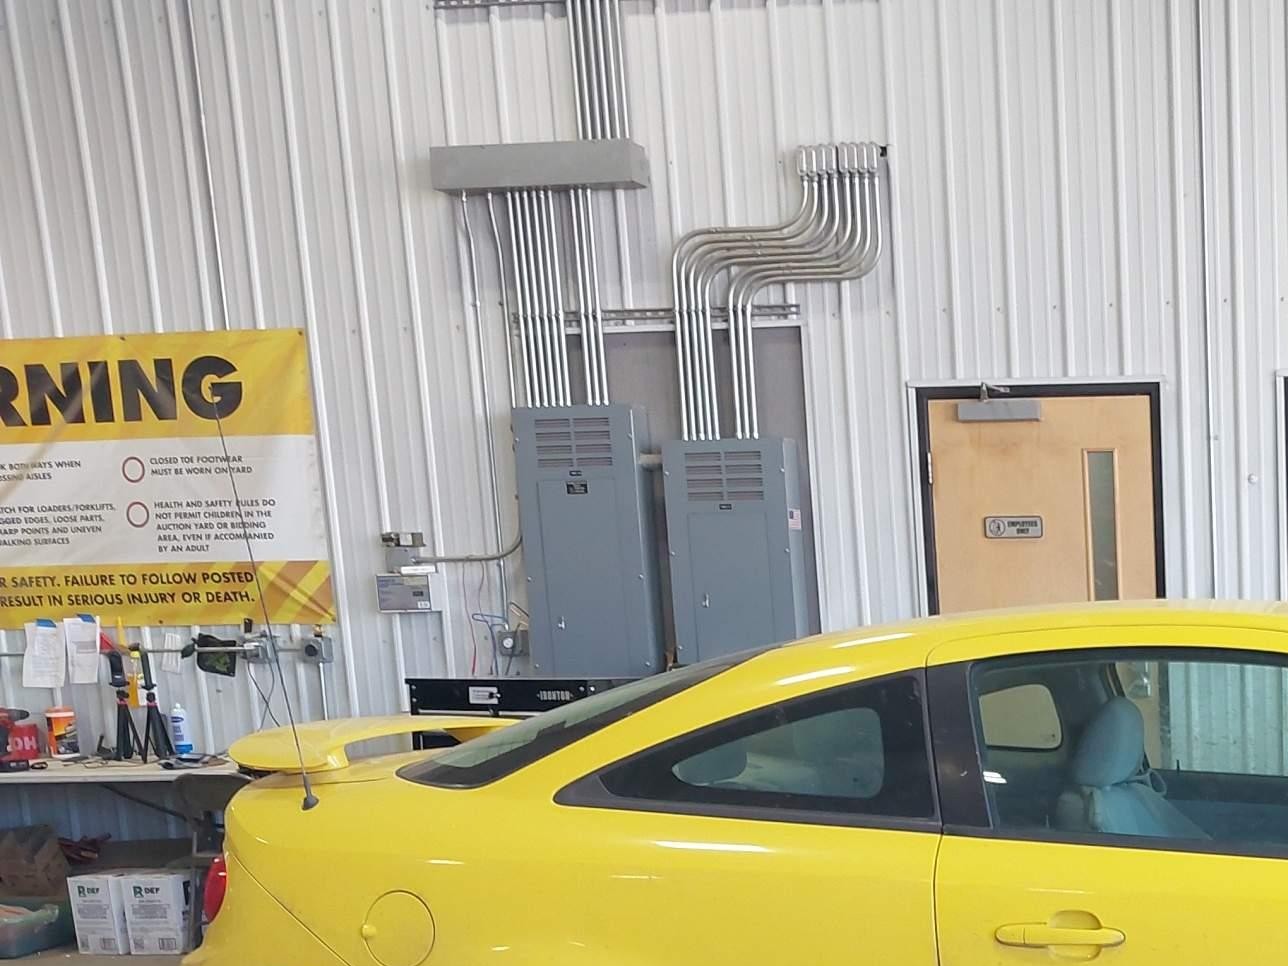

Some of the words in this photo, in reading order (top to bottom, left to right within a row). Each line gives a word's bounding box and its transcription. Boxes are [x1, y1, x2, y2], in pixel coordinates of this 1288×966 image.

[55, 460, 81, 469] WHEN
[150, 456, 178, 465] CLOSED
[180, 456, 194, 464] TOE
[196, 455, 243, 464] FOOTWEAR
[26, 471, 52, 480] AISLES
[151, 467, 172, 476] MUST
[174, 467, 183, 475] BE
[185, 466, 212, 475] WORN
[214, 466, 228, 474] ON
[229, 465, 253, 474] YARD
[154, 501, 183, 510] HEALTH
[185, 500, 202, 509] AND
[205, 499, 232, 508] SAFETY
[261, 498, 276, 507] DO
[18, 505, 35, 514] FOR
[155, 512, 172, 520] NOT
[174, 511, 201, 520] PERMIT
[203, 511, 241, 519] CHILDREN
[244, 510, 254, 518] IN
[256, 509, 272, 518] THE
[53, 514, 78, 524] LOOSE
[21, 526, 49, 535] POINTS
[51, 525, 69, 534] AND
[70, 524, 102, 534] UNEVEN
[156, 523, 192, 531] AUCTION
[194, 522, 215, 530] YARD
[216, 521, 228, 530] OR
[231, 521, 266, 530] BIDDING
[34, 536, 70, 546] SURFACES
[182, 532, 203, 542] EVEN
[205, 532, 211, 541] IF
[213, 531, 274, 541] ACCOMPANIED
[158, 545, 168, 553] BY
[170, 544, 183, 553] AN
[185, 543, 209, 552] ADULT
[11, 575, 61, 589] SAFETY.
[64, 574, 116, 588] FAILURE
[119, 573, 137, 586] TO
[142, 572, 197, 586] FOLLOW
[201, 571, 254, 584] POSTED
[0, 594, 43, 608] RESULT
[48, 593, 64, 607] IN
[67, 593, 124, 606] SERIOUS
[127, 592, 176, 605] INJURY
[181, 591, 202, 604] OR
[206, 590, 256, 603] DEATH.
[87, 886, 100, 895] DEF
[144, 886, 160, 895] DEF
